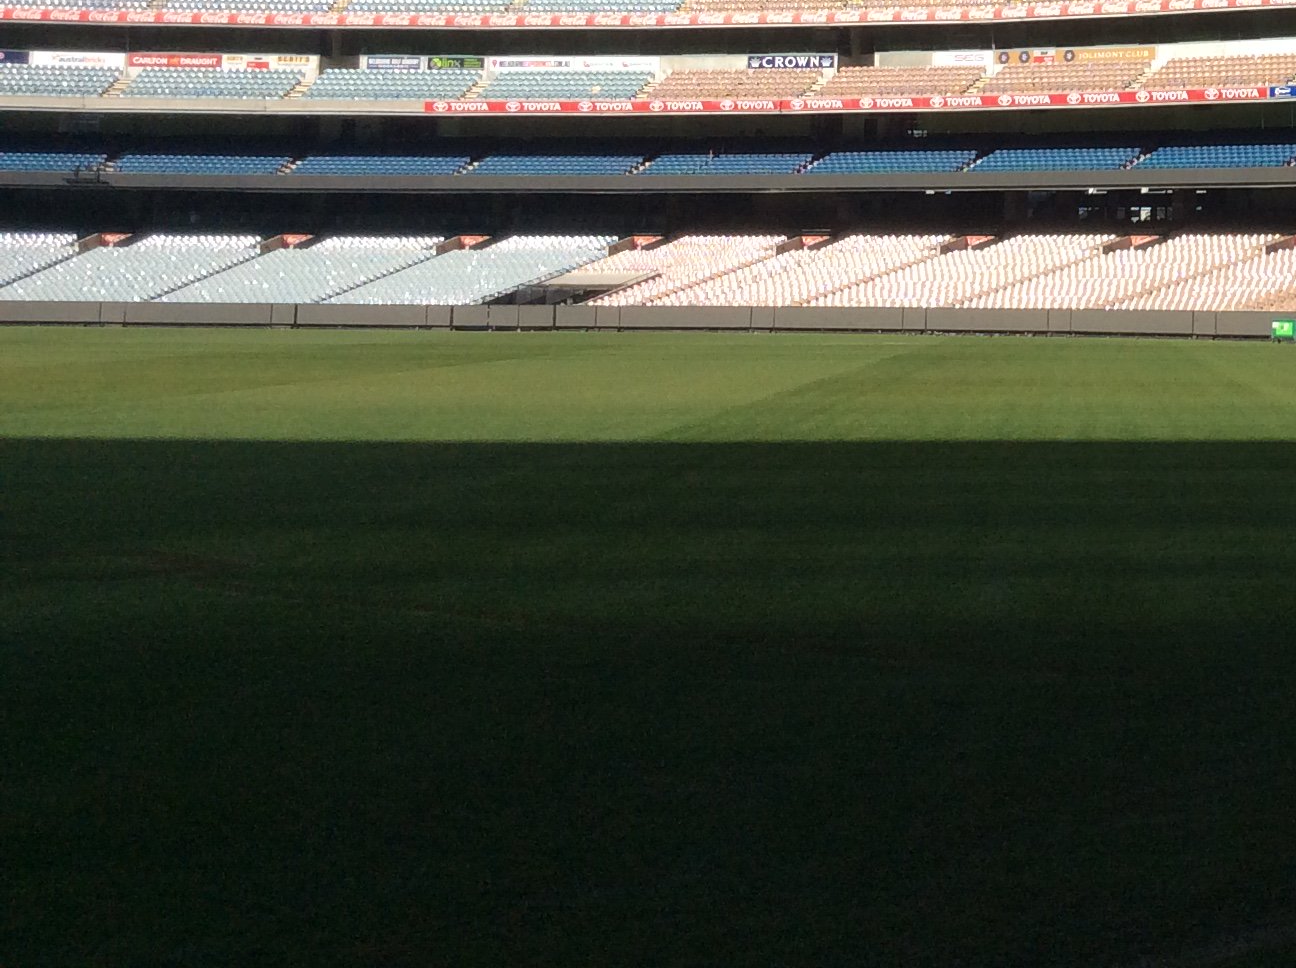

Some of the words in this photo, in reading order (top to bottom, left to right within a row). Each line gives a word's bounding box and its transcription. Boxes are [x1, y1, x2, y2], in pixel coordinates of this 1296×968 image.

[1126, 50, 1149, 58] CLUB
[133, 56, 168, 65] CARLTON
[180, 57, 218, 65] DRAUGHT
[761, 56, 820, 68] CROWN
[450, 102, 488, 111] TOYOTA
[522, 102, 561, 111] TOYOTA
[594, 102, 632, 111] TOYOTA
[665, 102, 703, 111] TOYOTA
[736, 101, 774, 110] TOYOTA
[806, 99, 843, 109] TOYOTA
[874, 98, 913, 108] TOYOTA
[945, 97, 982, 106] TOYOTA
[1012, 95, 1050, 105] TOYOTA
[1082, 93, 1120, 103] TOYOTA
[1151, 90, 1189, 101] TOYOTA
[1221, 88, 1259, 99] TOYOTA
